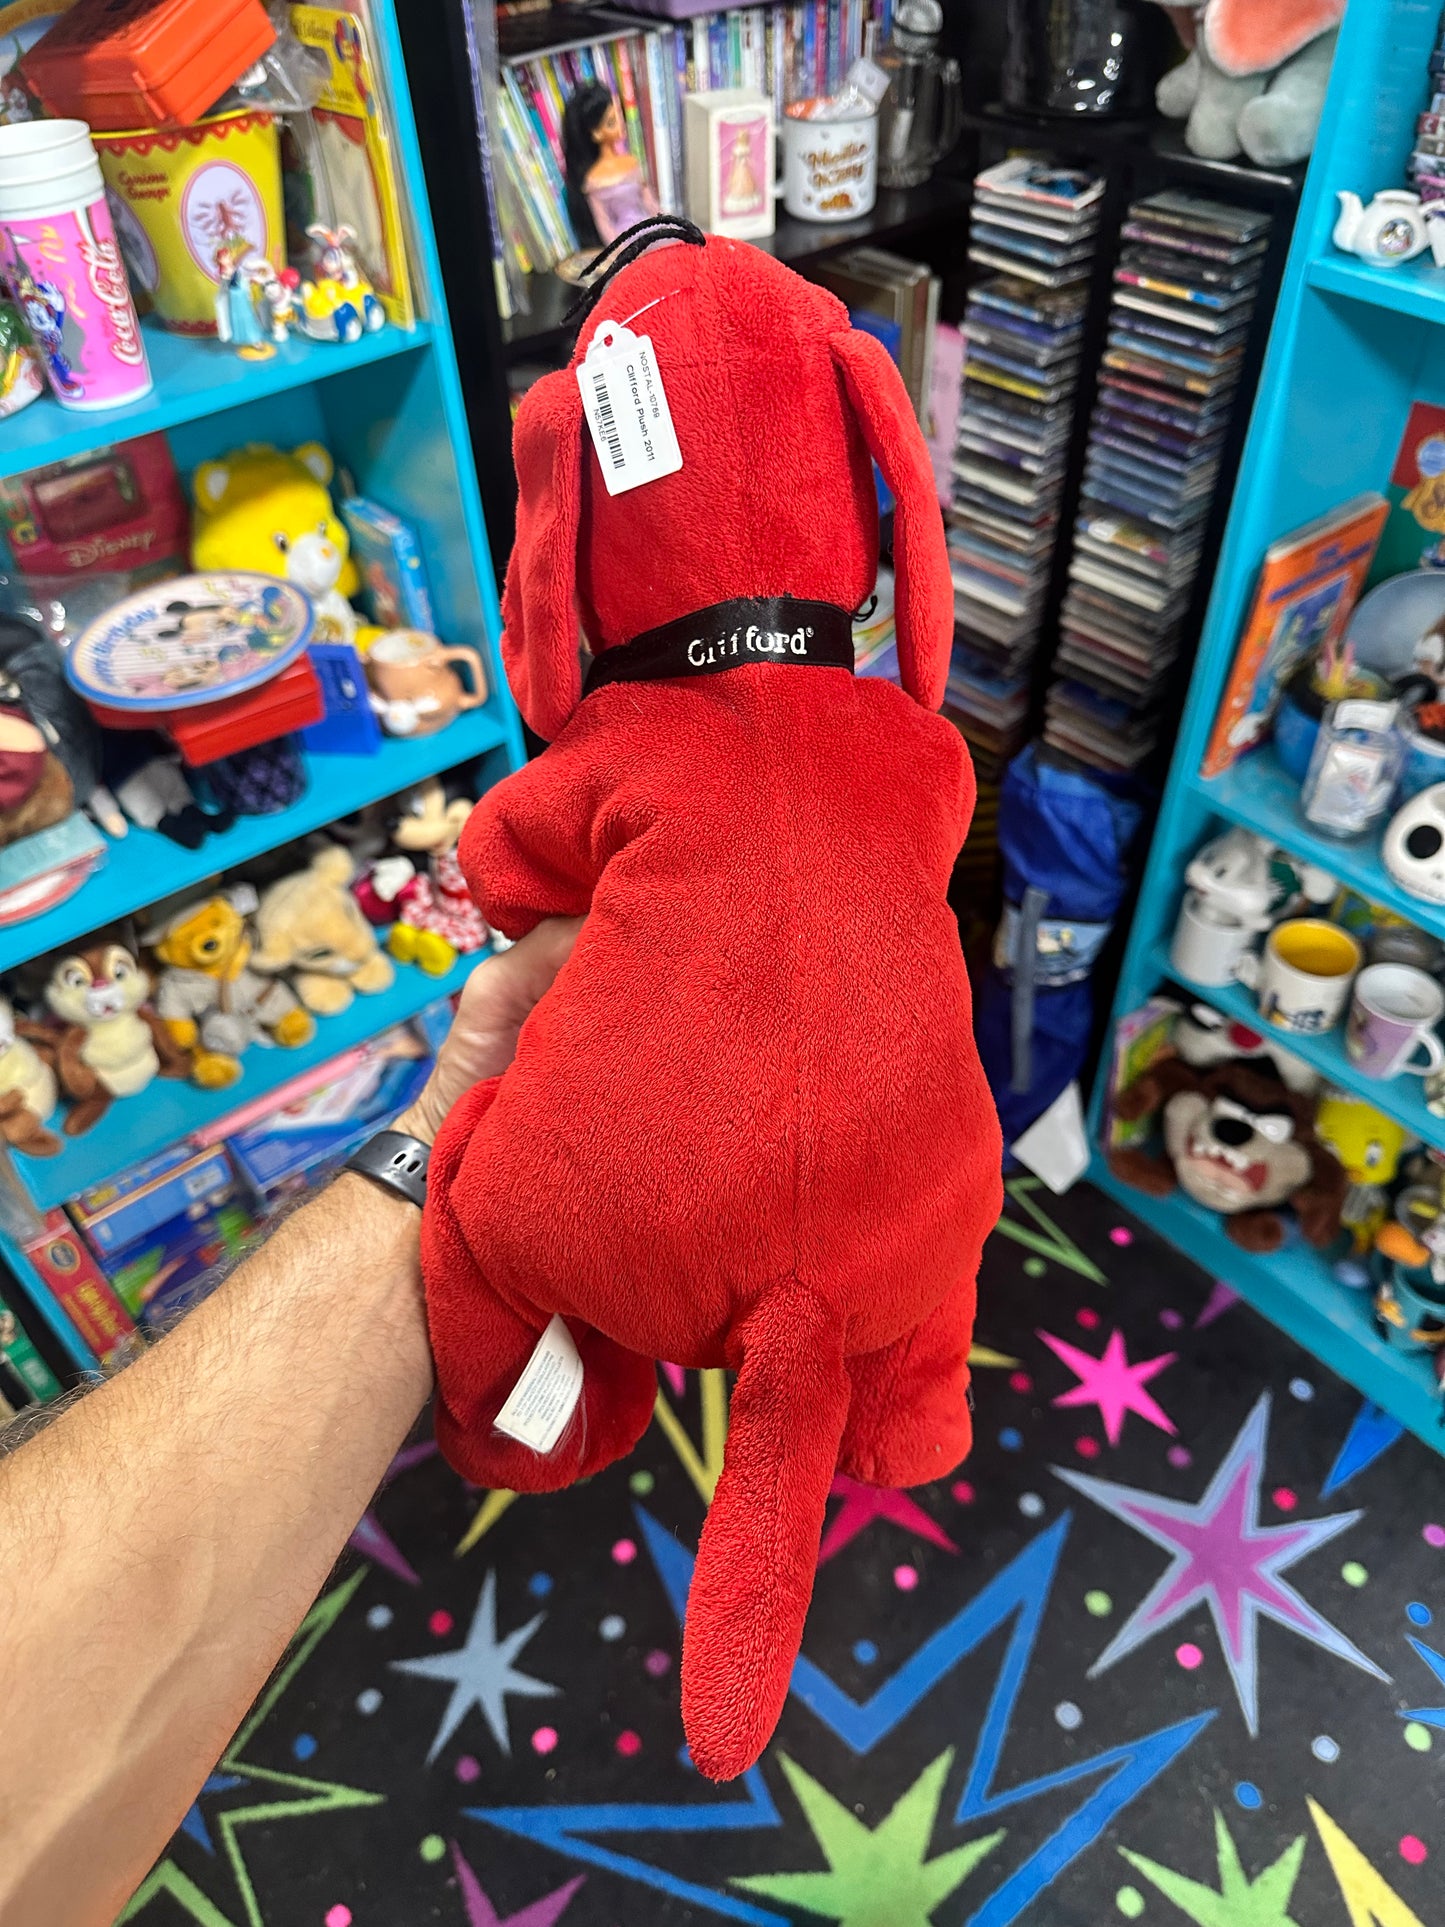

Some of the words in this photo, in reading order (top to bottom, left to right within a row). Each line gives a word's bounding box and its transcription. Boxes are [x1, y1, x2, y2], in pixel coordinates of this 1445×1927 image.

[626, 364, 641, 406] Clifford
[636, 408, 649, 437] Plush
[644, 440, 656, 462] 2011
